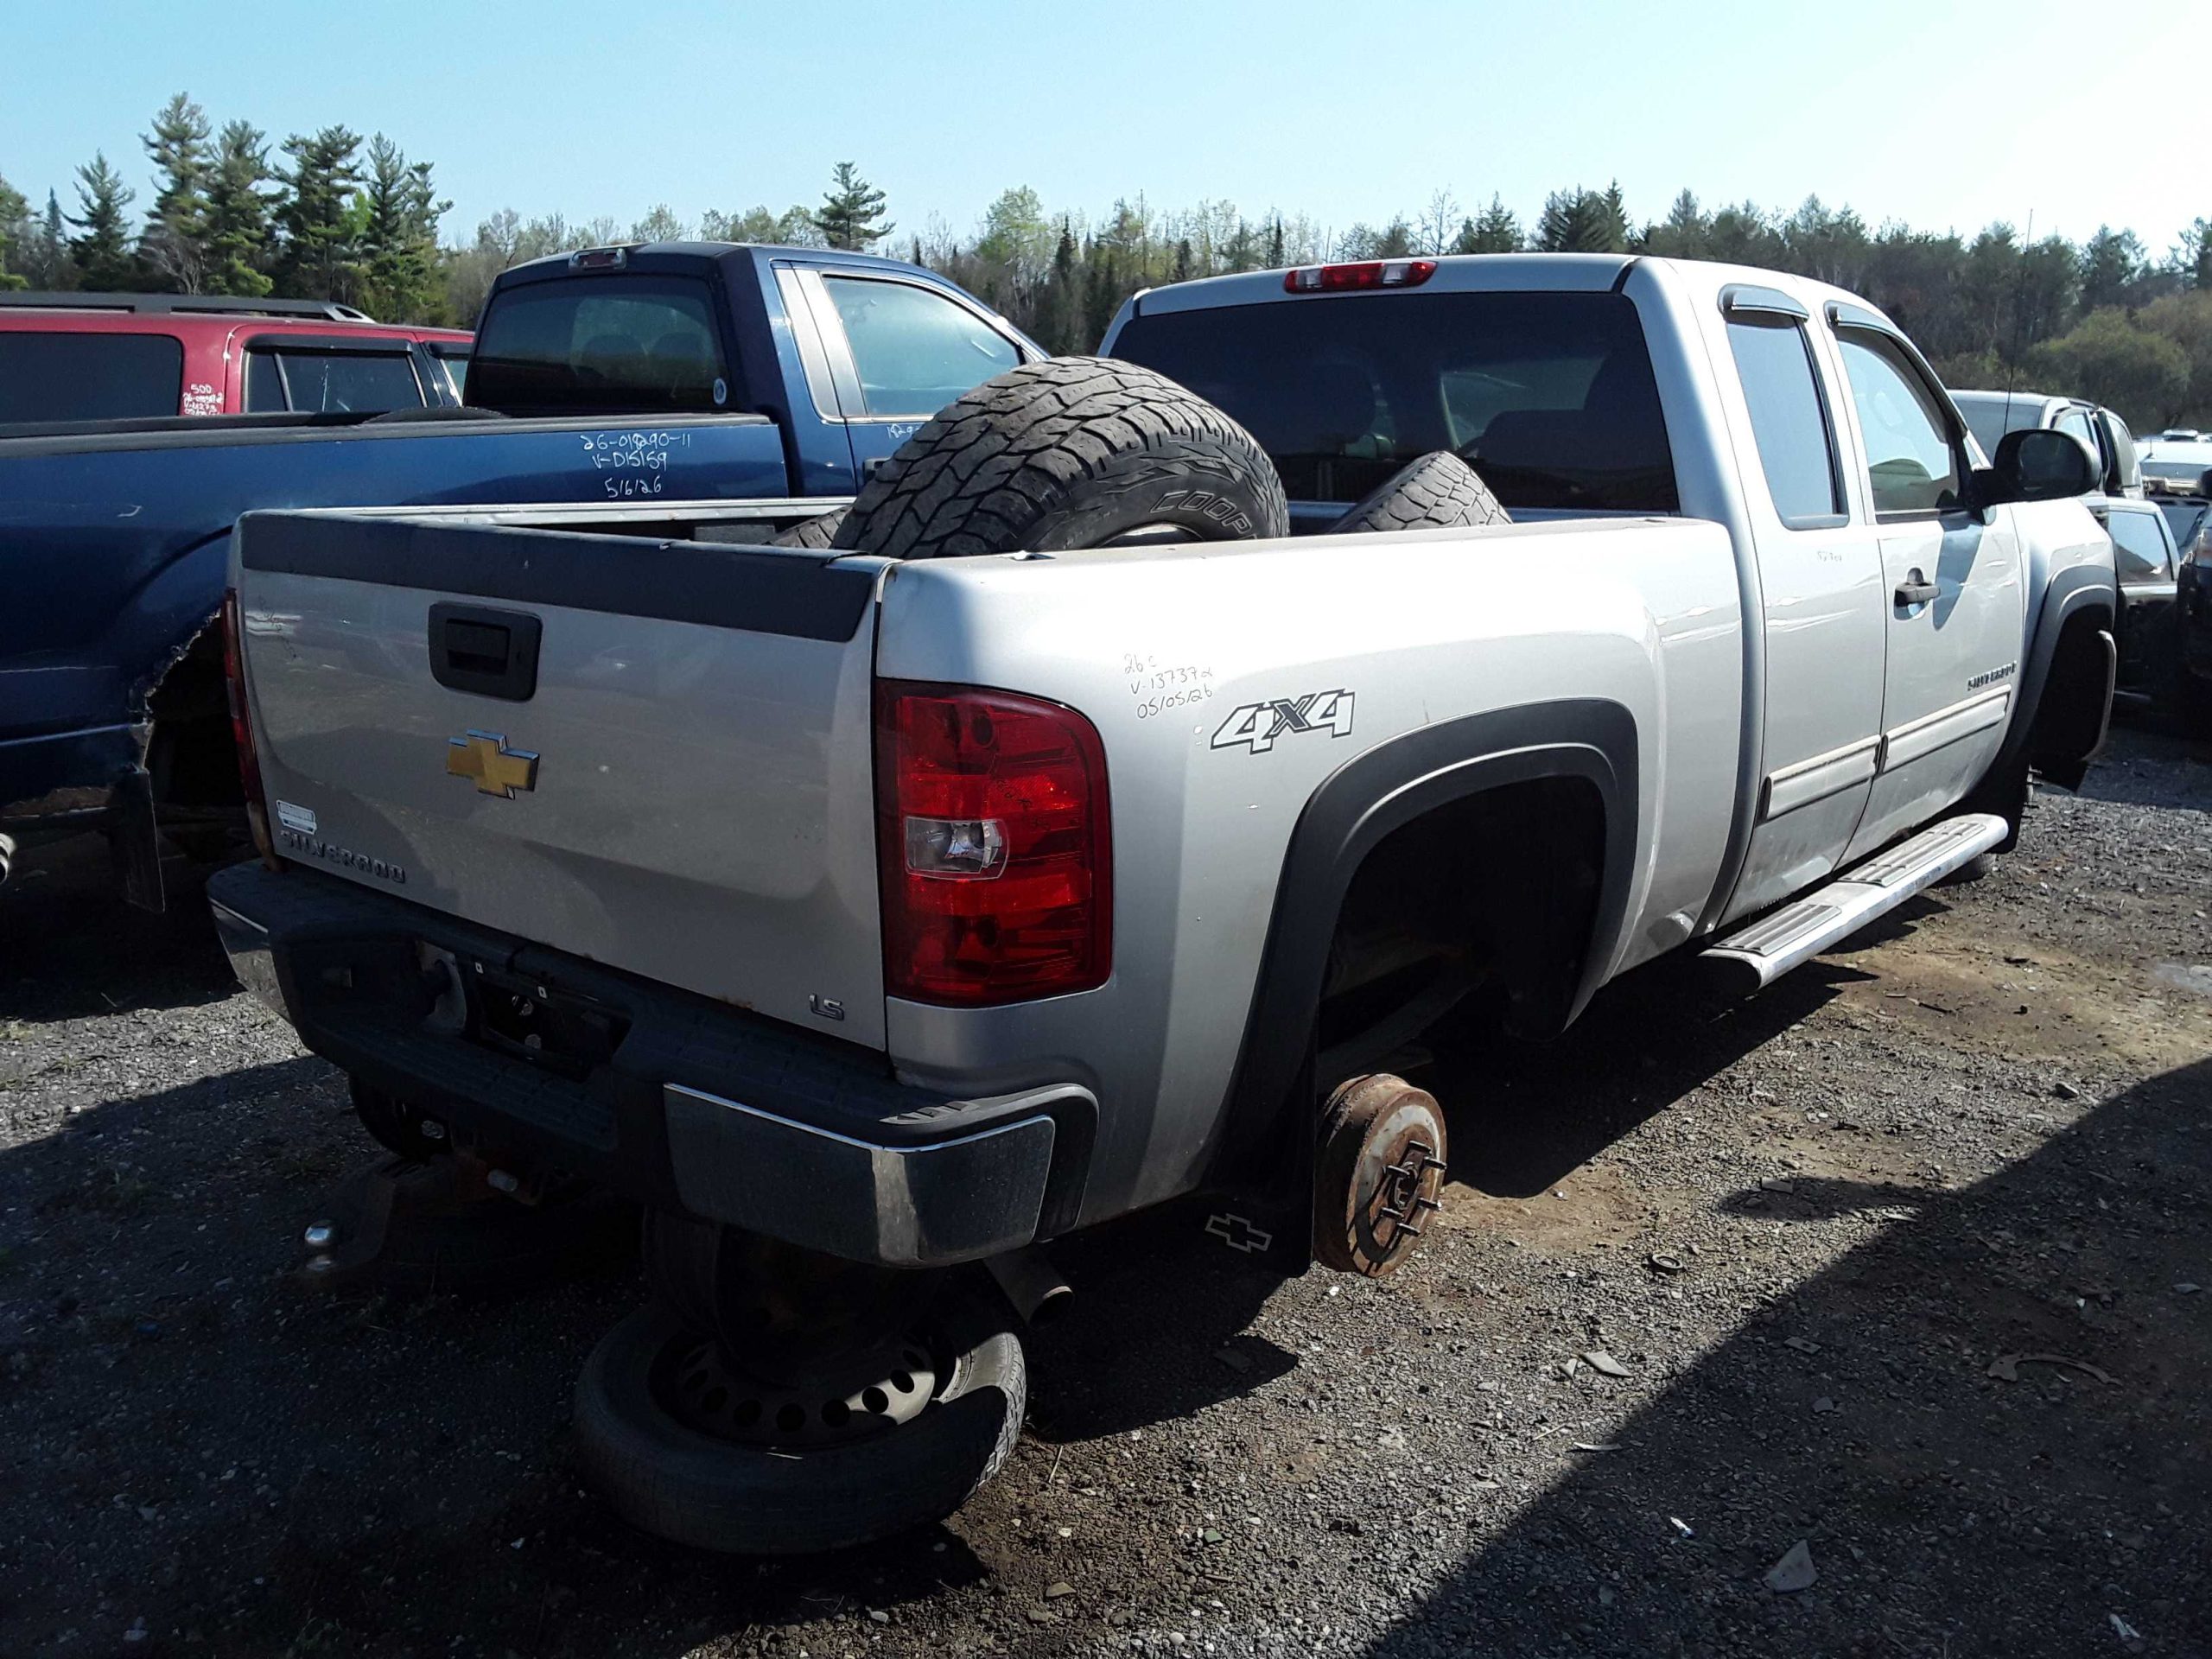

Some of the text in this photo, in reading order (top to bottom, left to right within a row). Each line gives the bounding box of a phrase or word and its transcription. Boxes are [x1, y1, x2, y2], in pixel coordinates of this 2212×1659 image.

[190, 383, 213, 395] 500
[1150, 489, 1258, 540] COOP
[808, 994, 845, 1021] LS
